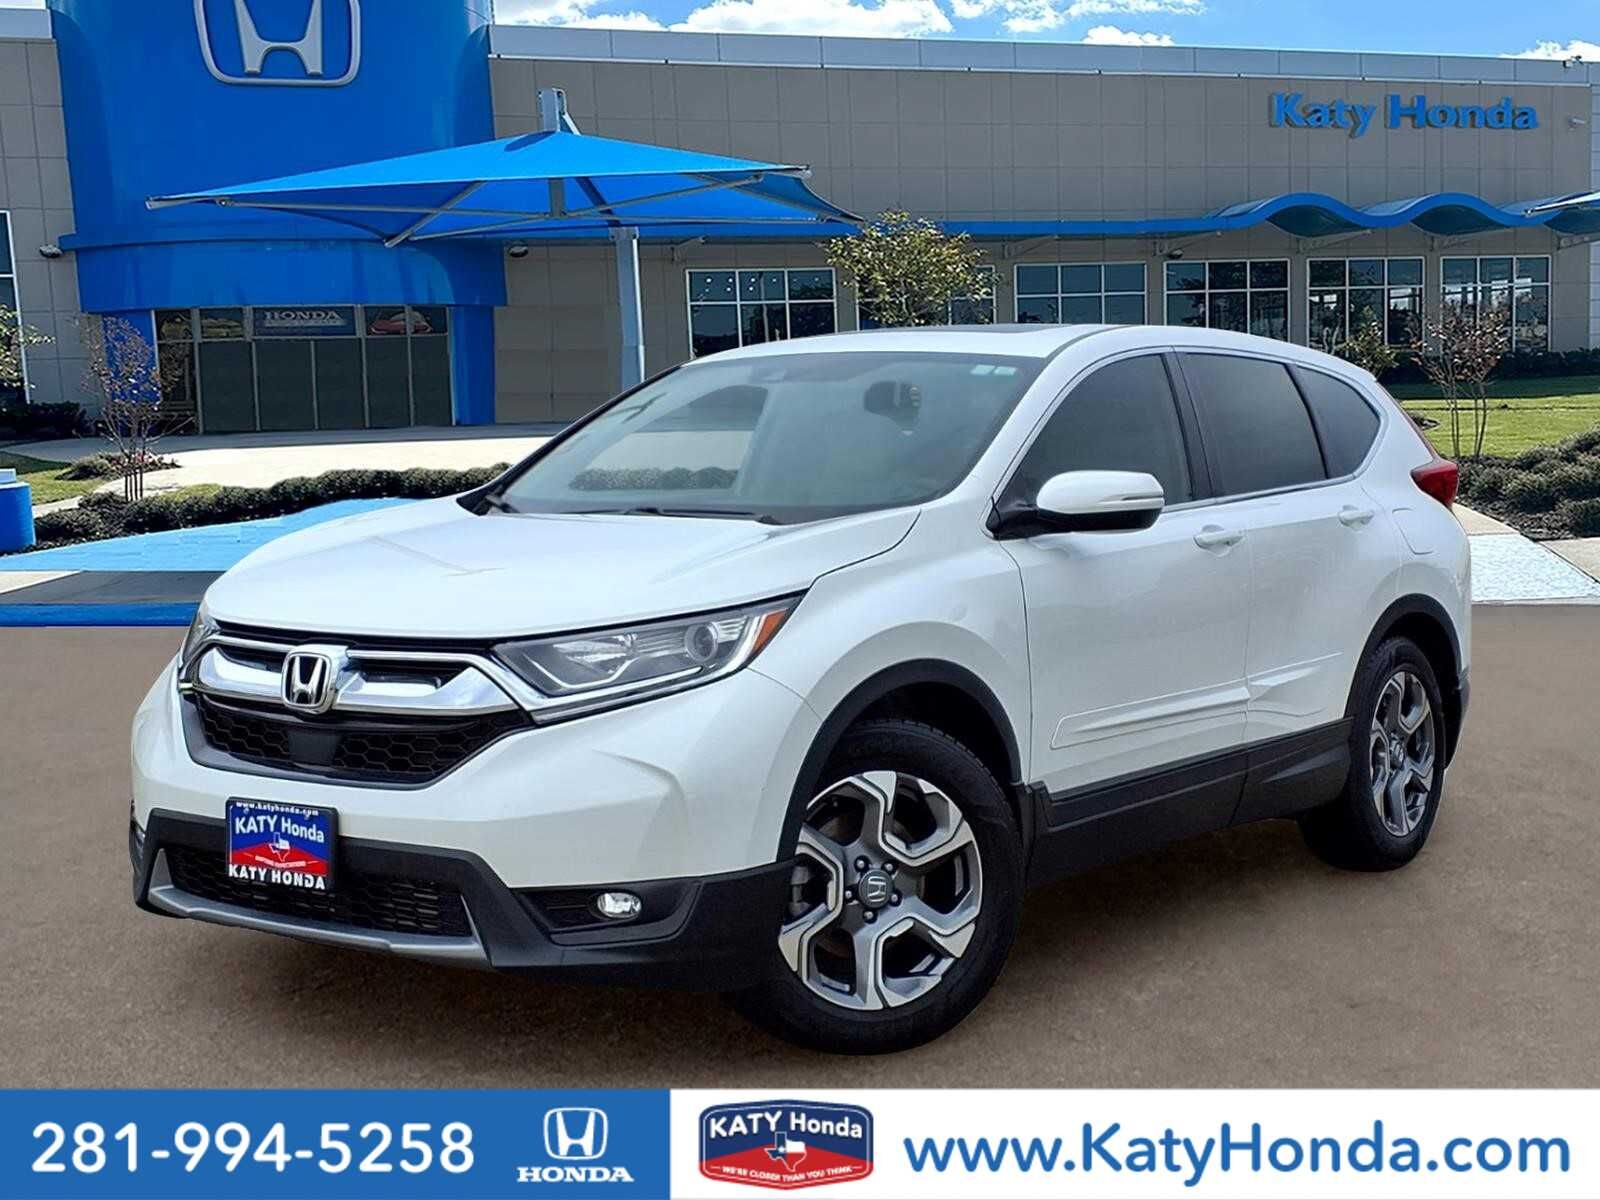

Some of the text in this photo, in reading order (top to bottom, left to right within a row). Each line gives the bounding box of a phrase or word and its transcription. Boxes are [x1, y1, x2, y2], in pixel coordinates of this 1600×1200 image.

[1271, 92, 1540, 138] Katy Honda
[264, 311, 343, 320] HONDA
[234, 814, 325, 843] KATY Honda
[228, 863, 326, 890] KATY HONDA
